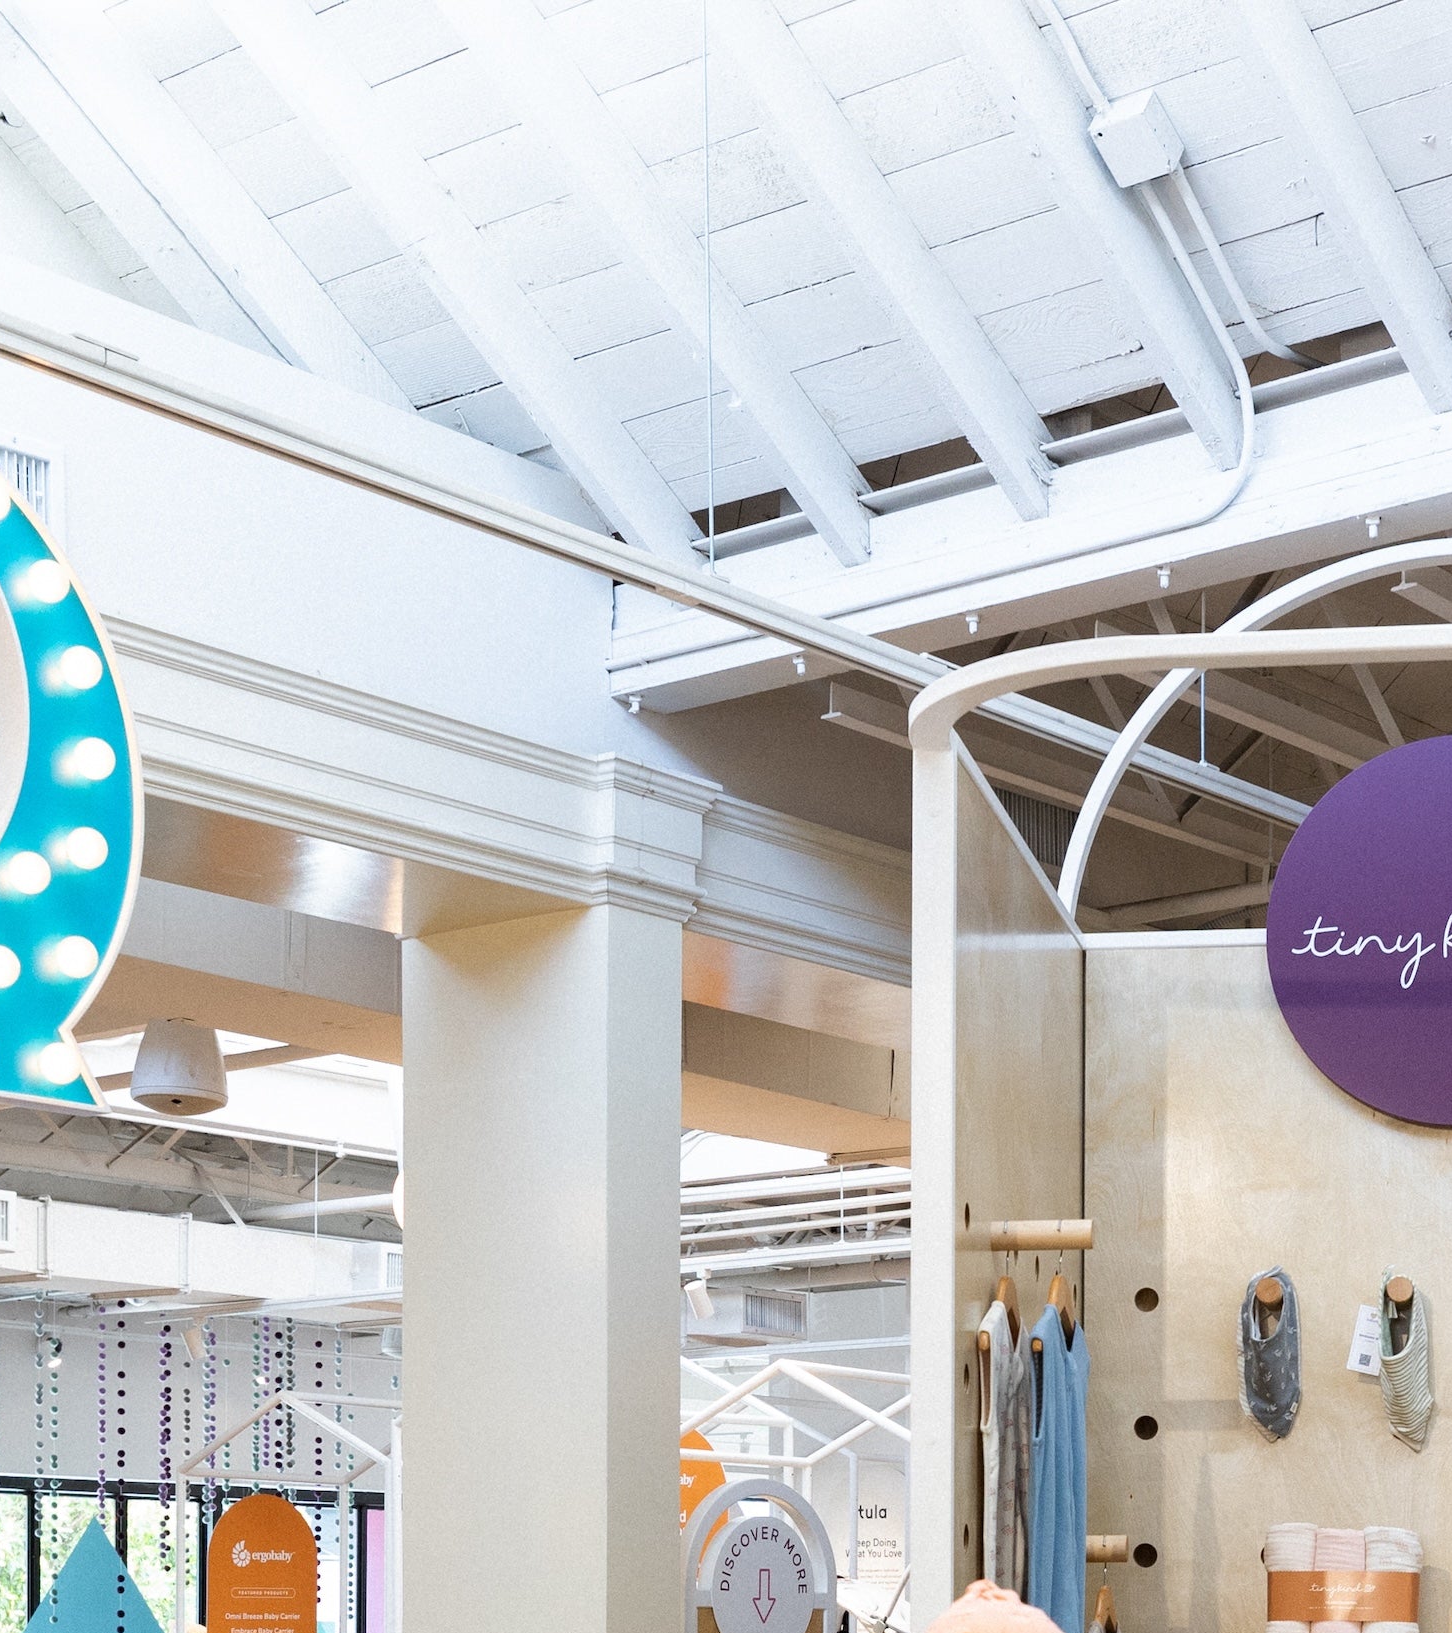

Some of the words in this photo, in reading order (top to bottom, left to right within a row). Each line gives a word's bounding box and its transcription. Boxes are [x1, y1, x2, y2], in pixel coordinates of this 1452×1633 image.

[1291, 915, 1437, 990] tiny
[873, 1538, 897, 1549] Doing
[251, 1549, 293, 1564] ergobaby
[720, 1526, 779, 1591] DISCOVER
[783, 1538, 808, 1594] MORE
[867, 1549, 882, 1558] You
[884, 1549, 903, 1558] Love
[225, 1612, 242, 1620] Omni
[242, 1612, 263, 1620] Breeze
[264, 1612, 279, 1621] Baby
[280, 1612, 301, 1620] Carrier
